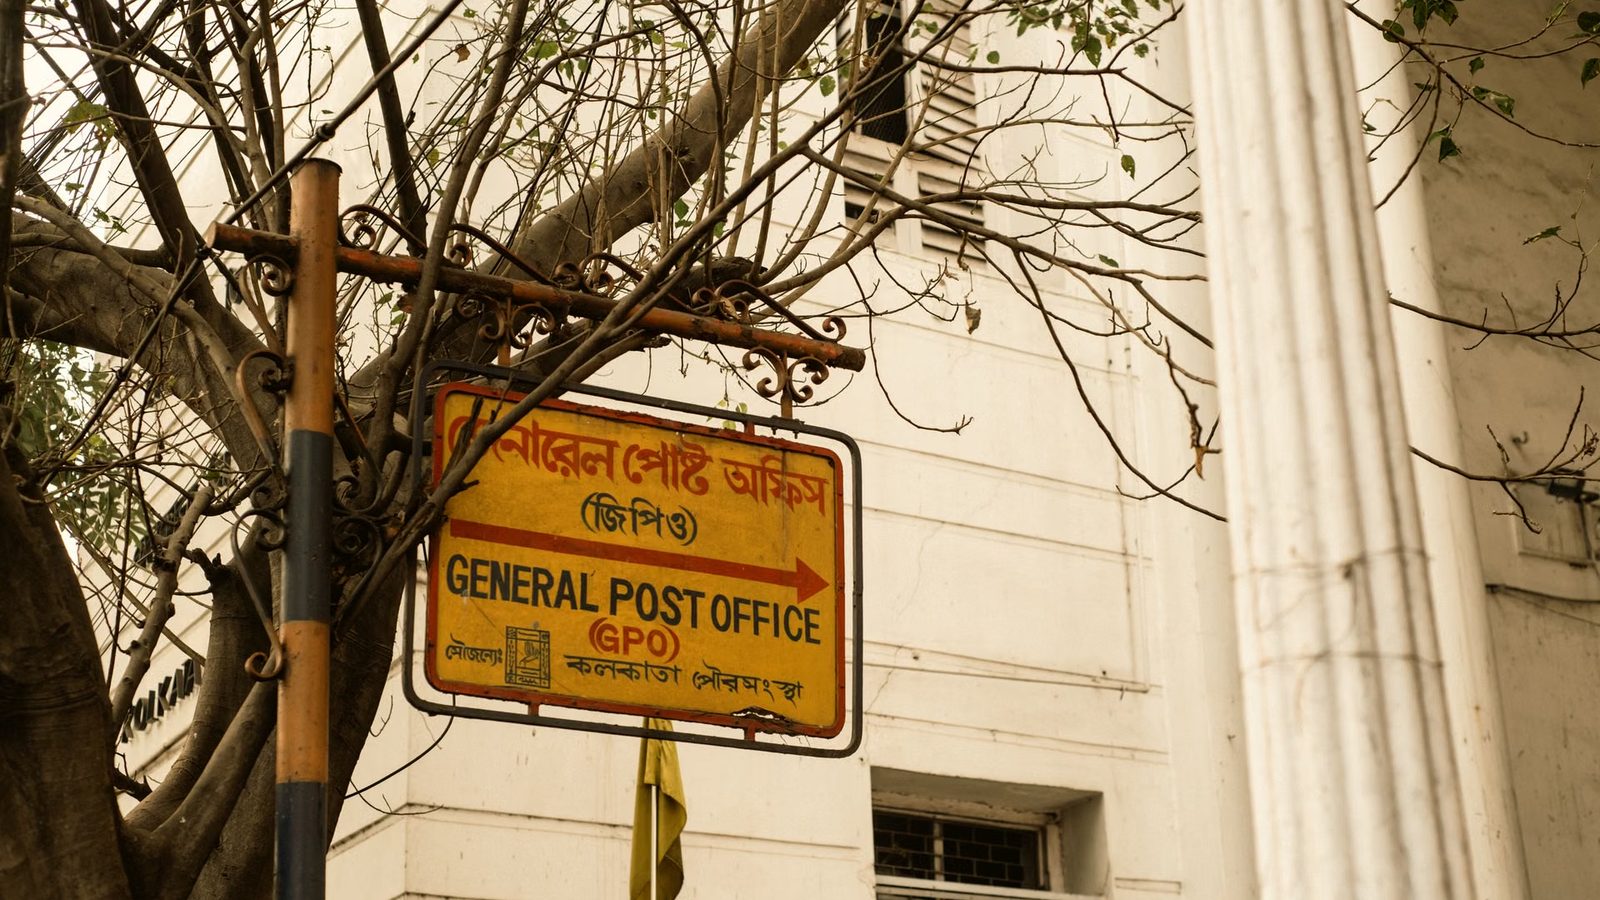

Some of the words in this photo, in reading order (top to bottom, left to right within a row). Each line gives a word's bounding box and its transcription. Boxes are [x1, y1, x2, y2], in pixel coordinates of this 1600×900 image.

[720, 454, 829, 517] অফিস
[581, 491, 698, 546] (জিপিও)
[446, 554, 599, 612] GENERAL
[610, 577, 705, 633] POST
[711, 594, 821, 645] OFFICE
[588, 617, 681, 663] (GPO)
[563, 654, 682, 686] কলকাতা
[692, 659, 804, 708] পৌরসংস্থা
